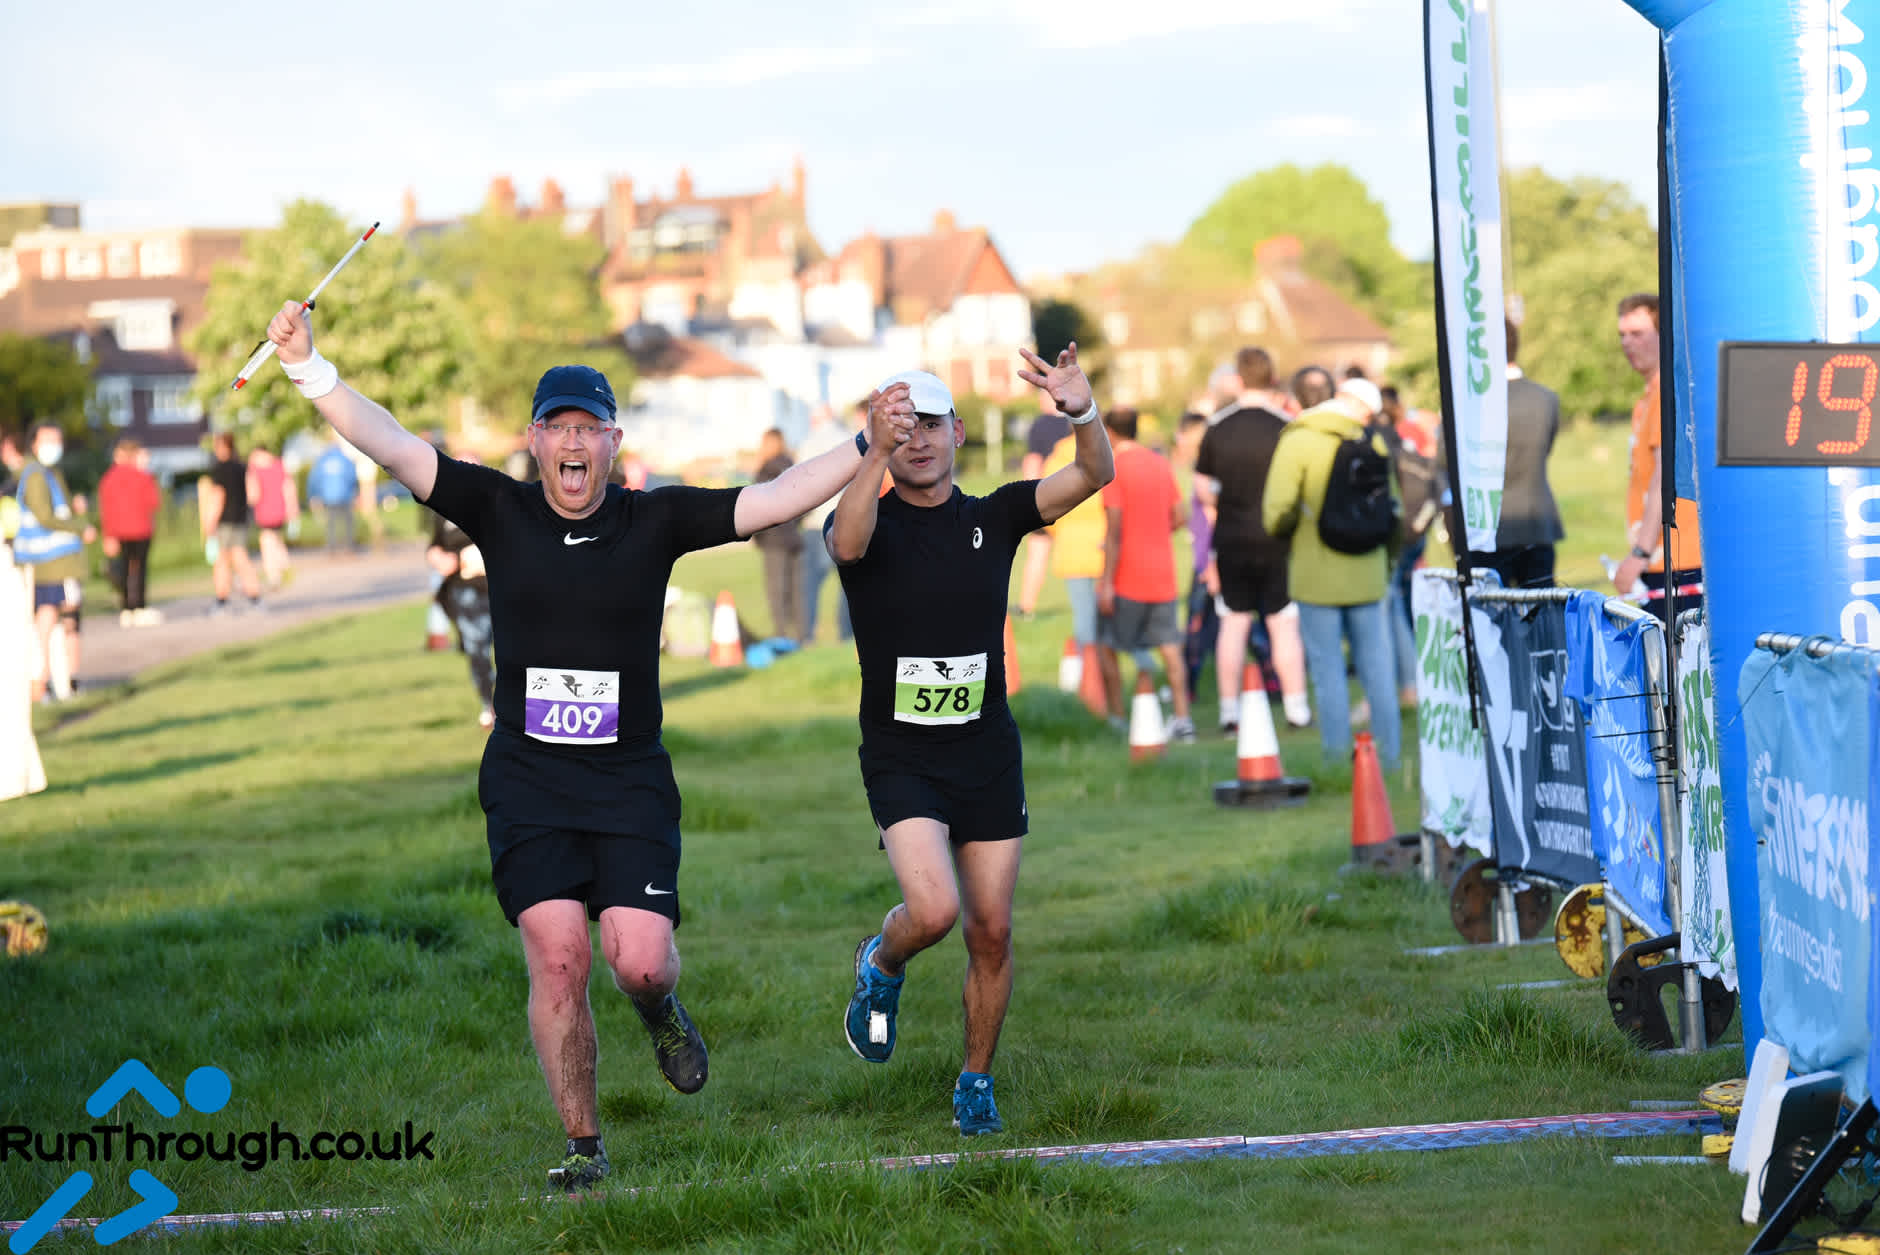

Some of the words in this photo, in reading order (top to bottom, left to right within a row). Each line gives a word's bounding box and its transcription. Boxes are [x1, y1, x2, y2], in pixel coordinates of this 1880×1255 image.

[1784, 354, 1878, 456] 19
[913, 686, 970, 713] 578
[541, 703, 603, 735] 409
